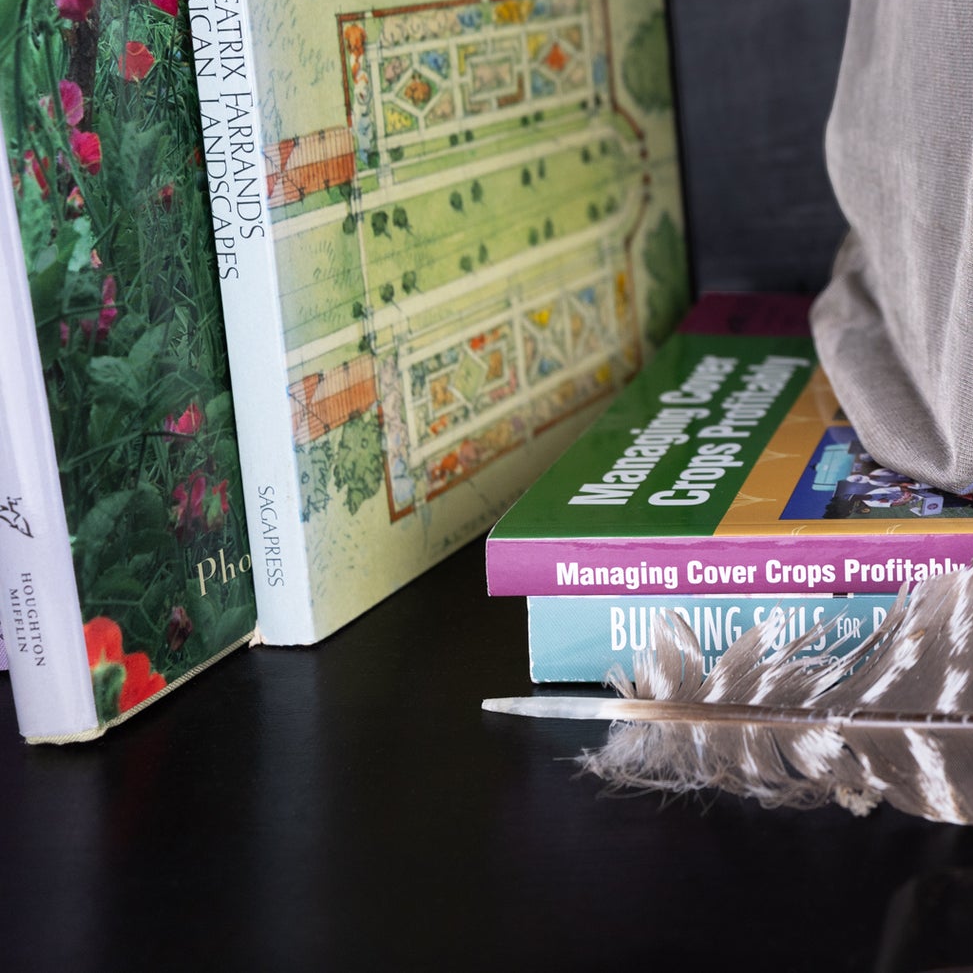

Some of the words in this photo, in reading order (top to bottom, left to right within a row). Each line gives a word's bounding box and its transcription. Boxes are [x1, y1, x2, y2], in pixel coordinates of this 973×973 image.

[200, 98, 239, 280] LANDSCAPES
[220, 92, 265, 240] FARRAND'S
[567, 408, 711, 506] Managing
[658, 355, 740, 405] Cover
[647, 442, 745, 507] Crops
[697, 355, 810, 439] Profitably
[257, 485, 285, 588] SAGAPRESS
[556, 561, 679, 590] Managing
[686, 560, 757, 585] Cover
[765, 559, 836, 588] Crops
[9, 588, 28, 653] MIFFLIN
[21, 572, 46, 667] HOUGHTON
[836, 617, 861, 639] FOR
